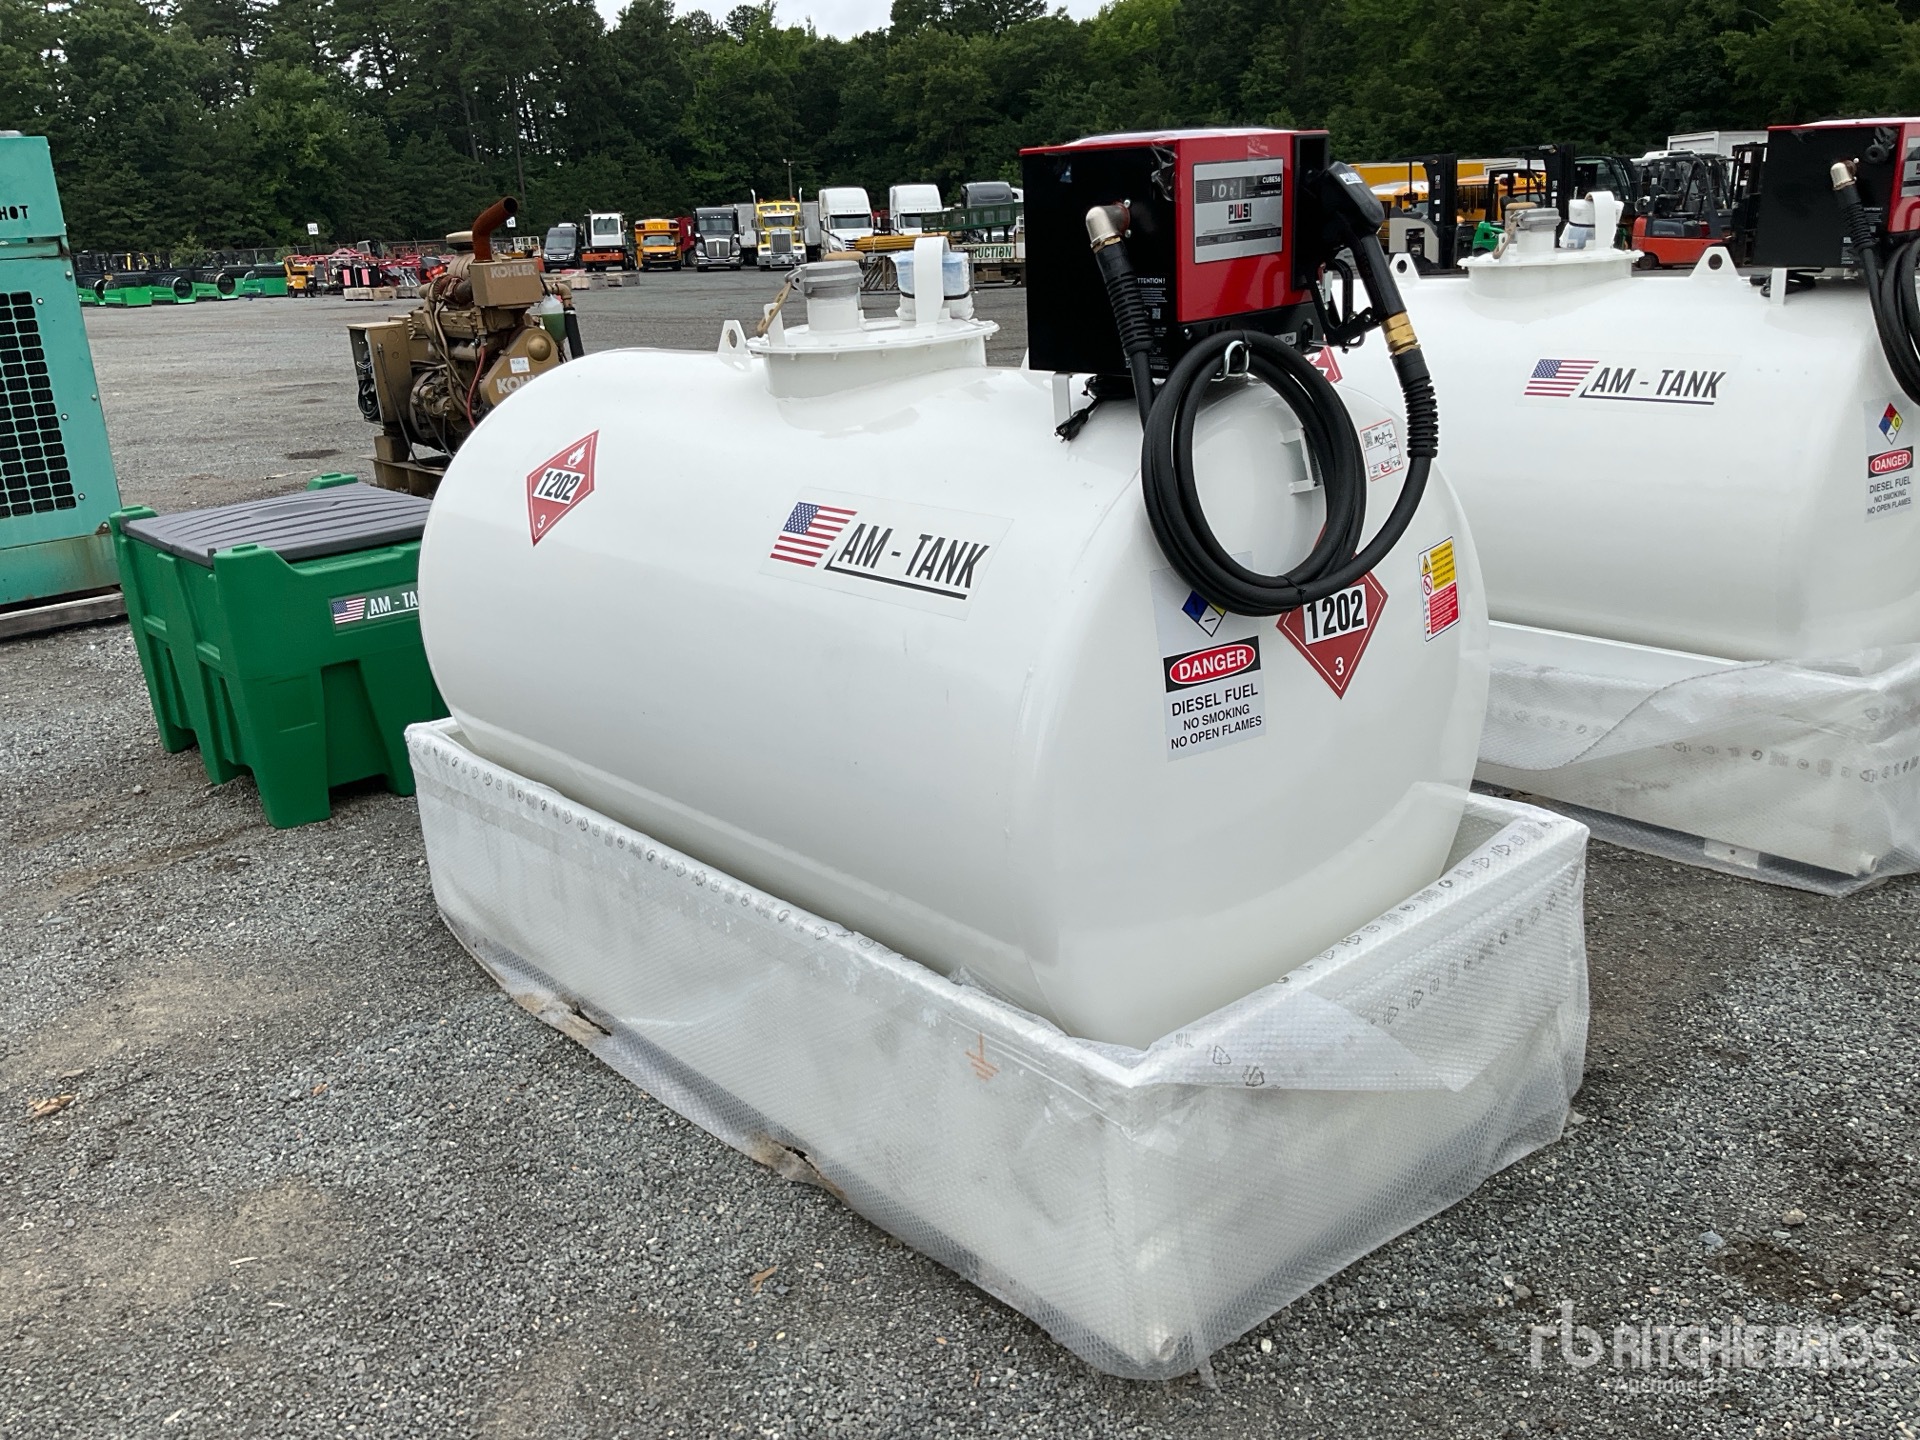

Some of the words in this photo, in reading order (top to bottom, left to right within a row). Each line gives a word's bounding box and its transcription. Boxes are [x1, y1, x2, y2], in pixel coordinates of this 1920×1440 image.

[0, 205, 28, 220] HOT
[1228, 203, 1252, 219] PIUSI
[490, 264, 536, 278] KOHLER
[1589, 367, 1637, 394] AM
[1655, 369, 1727, 399] TANK
[1874, 453, 1908, 471] DANGER
[537, 470, 581, 501] 1202
[1869, 480, 1893, 494] DIESEL
[1895, 476, 1911, 488] FUEL
[1874, 494, 1883, 503] NO
[1883, 489, 1906, 502] SMOKING
[1867, 506, 1876, 514] NO
[1876, 503, 1891, 512] OPEN
[1891, 497, 1911, 509] FLAMES
[537, 514, 546, 529] 3
[837, 523, 894, 569] AM
[905, 533, 990, 589] TANK
[370, 596, 391, 614] AM
[401, 590, 418, 608] TA
[1307, 589, 1365, 639] 1202
[1179, 649, 1248, 681] DANGER
[1335, 656, 1345, 676] 3
[1171, 692, 1221, 717] DIESEL
[1225, 682, 1258, 703] FUEL
[1183, 717, 1200, 731] NO
[1202, 704, 1250, 727] SMOKING
[1171, 736, 1188, 750] NO
[1189, 727, 1219, 745] OPEN
[1222, 715, 1262, 736] FLAMES
